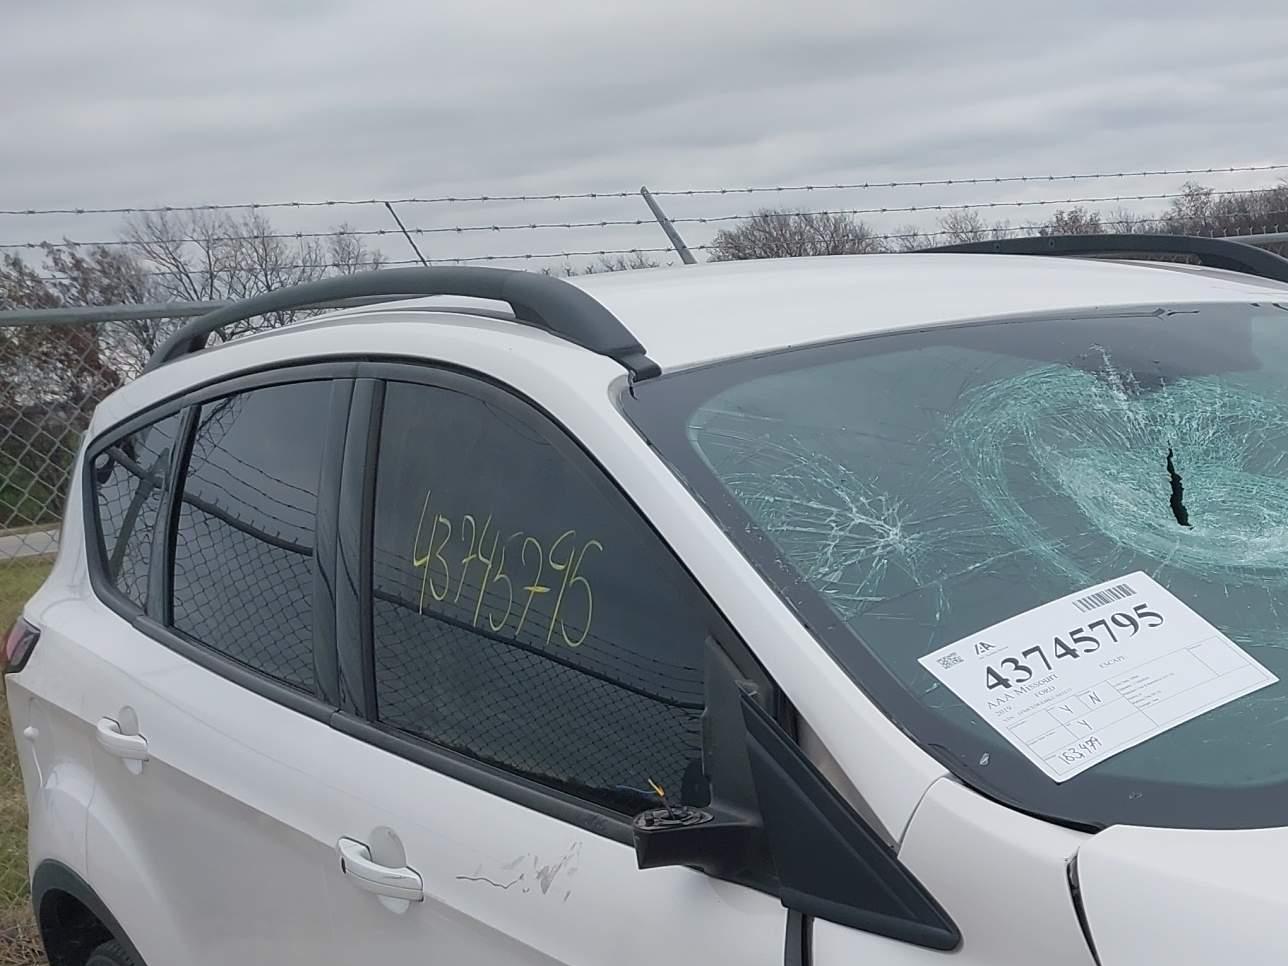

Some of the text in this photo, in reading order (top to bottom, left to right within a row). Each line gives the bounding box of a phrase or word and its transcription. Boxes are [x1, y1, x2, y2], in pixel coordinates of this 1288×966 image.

[985, 602, 1164, 690] 43745795
[988, 693, 1015, 710] AAA
[1013, 673, 1058, 694] Missouri
